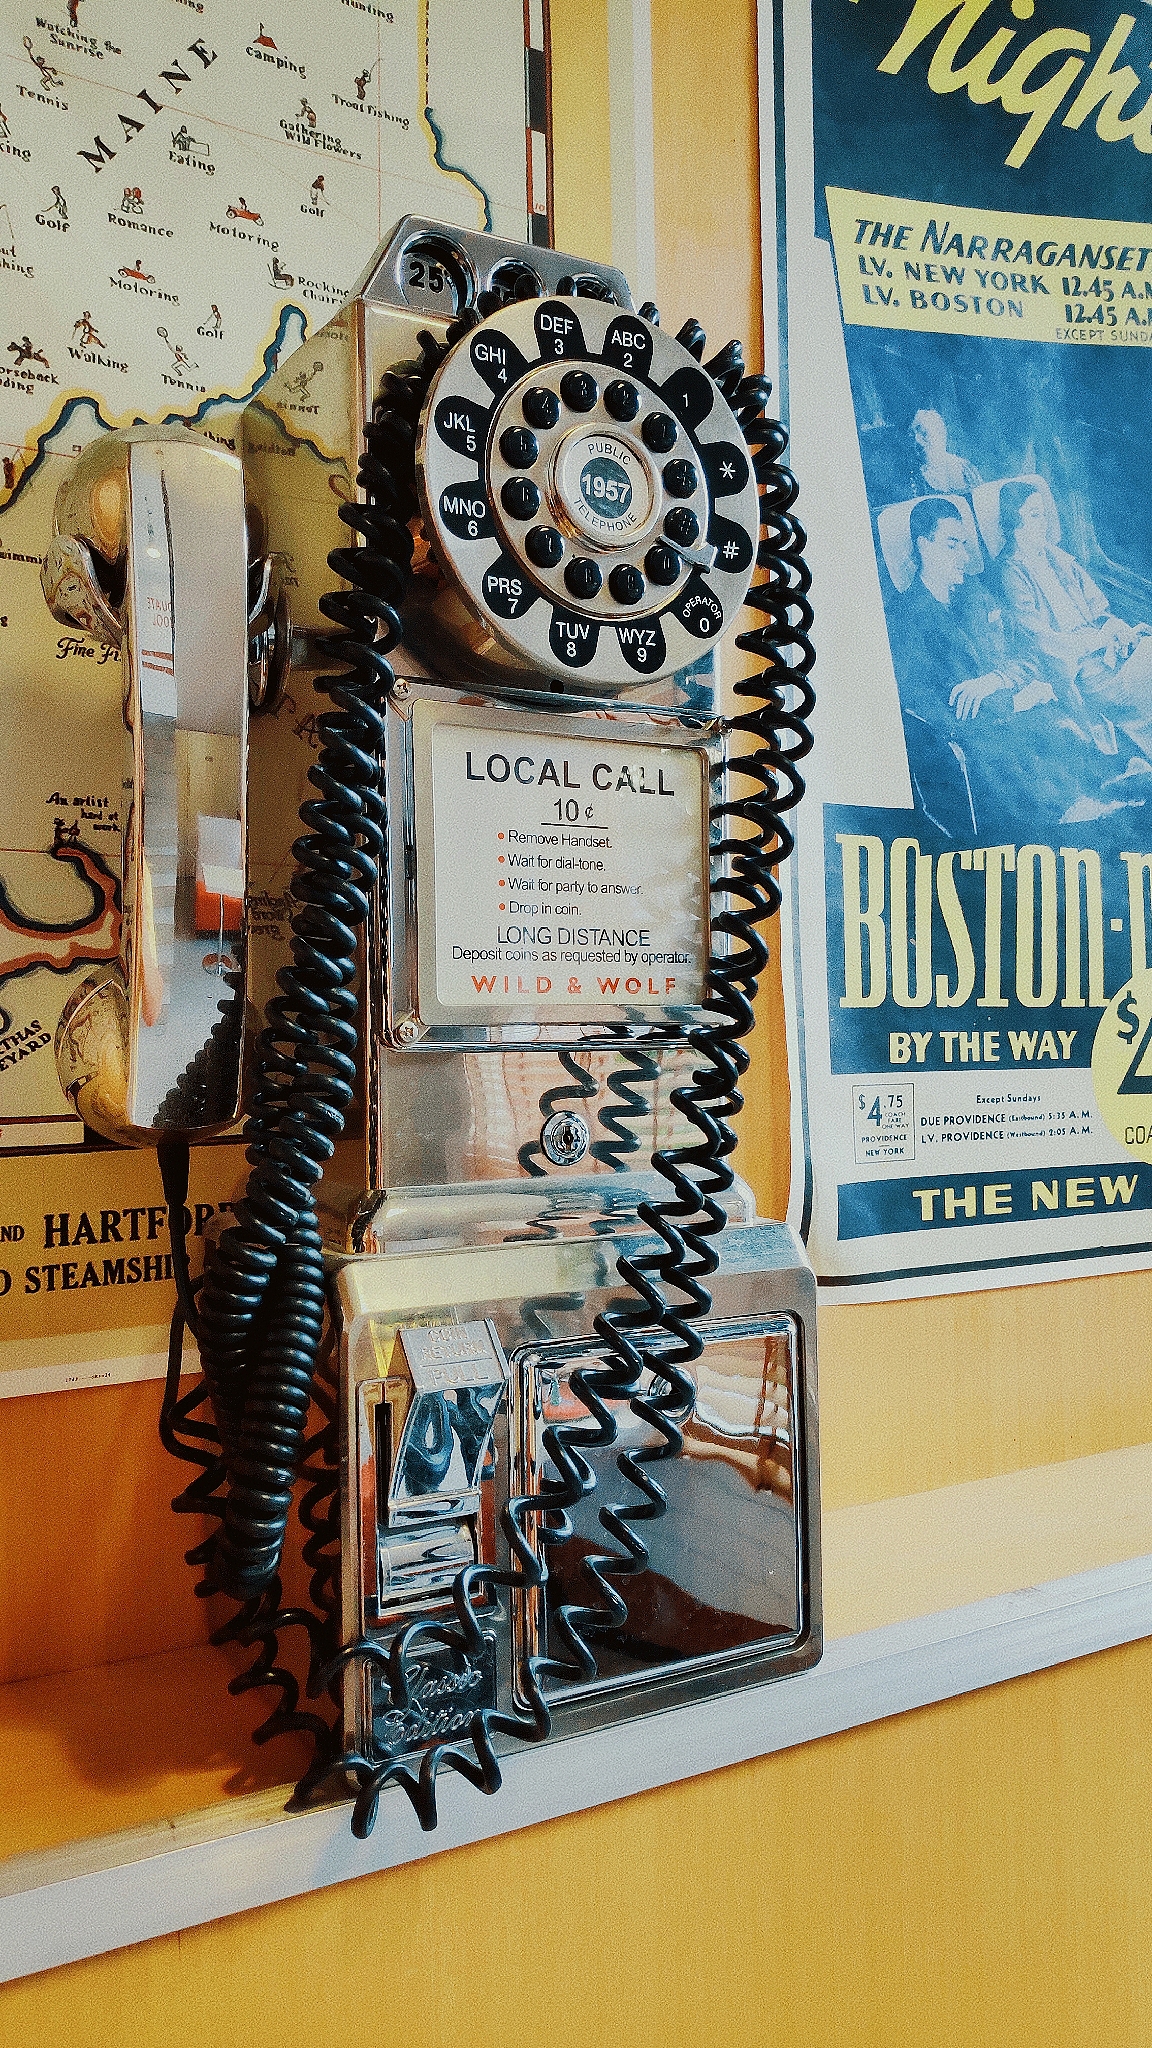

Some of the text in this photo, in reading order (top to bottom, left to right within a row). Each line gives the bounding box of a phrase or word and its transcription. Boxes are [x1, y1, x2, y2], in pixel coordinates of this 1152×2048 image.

[49, 33, 104, 59] Sunrise
[245, 46, 307, 79] Camping
[849, 0, 1152, 169] Nigh
[16, 84, 69, 111] Tennis
[76, 37, 219, 174] MAINE
[279, 118, 342, 148] Gathering
[284, 129, 362, 160] Wild Flowers
[169, 151, 216, 176] Eating
[300, 203, 326, 218] Golf
[35, 213, 71, 233] Golf
[107, 212, 174, 238] Romance
[209, 220, 280, 252] Motoring
[854, 219, 914, 250] THE
[408, 261, 445, 293] 25
[858, 254, 893, 279] LV.
[904, 261, 967, 286] NEW
[974, 268, 1051, 296] YORK
[1061, 275, 1115, 302] 12.45
[109, 276, 181, 306] Motoring
[298, 276, 350, 300] Rocking
[862, 284, 900, 307] LV.
[909, 289, 1024, 318] BOSTON
[1064, 303, 1118, 326] 12.45
[196, 326, 225, 340] Golf
[540, 313, 574, 335] DEF
[1056, 327, 1152, 342] EXCEPT SUND
[554, 339, 564, 355] 3
[611, 329, 646, 350] ABC
[67, 346, 129, 374] Walking
[474, 343, 507, 366] GHI
[624, 353, 634, 368] 2
[161, 373, 206, 394] Tennis
[497, 368, 508, 384] 4
[682, 392, 689, 409] 1
[443, 412, 477, 433] JKL
[466, 435, 477, 452] 5
[588, 442, 631, 466] PUBLIC
[581, 473, 631, 504] 1957
[443, 495, 486, 519] MNO
[574, 496, 637, 532] TELEPHONE
[467, 520, 479, 537] 6
[722, 540, 740, 560] #
[487, 576, 523, 596] PRS
[507, 598, 518, 614] 7
[682, 595, 722, 620] OPERATOR
[555, 621, 590, 640] TUV
[700, 617, 710, 633] 0
[618, 627, 657, 647] WYZ
[56, 636, 95, 660] Fine
[566, 641, 577, 657] 8
[637, 647, 647, 663] 9
[465, 751, 676, 797] LOCAL CALL
[508, 829, 613, 849] Remove Handset.
[508, 853, 607, 872] Wait for dial-tone.
[508, 877, 644, 896] Wait for party to answer.
[509, 900, 582, 917] Drop in coin.
[497, 925, 651, 947] LONG DISTANCE
[452, 945, 692, 966] Deposit coins as requested by operator.
[471, 975, 676, 995] WILD & WOLF
[889, 1030, 1078, 1065] BY THE WAY
[976, 1093, 1041, 1104] Except Sundays
[920, 1116, 941, 1126] DUE
[944, 1113, 1006, 1125] PROVIDENCE
[1048, 1112, 1066, 1120] 5:35
[861, 1134, 907, 1143] PROVIDENCE
[942, 1130, 1004, 1142] PROVIDENCE
[1048, 1127, 1066, 1137] 2:05
[866, 1147, 905, 1157] NEW YORK
[912, 1174, 1139, 1222] THE NEW
[428, 1363, 489, 1387] PULL
